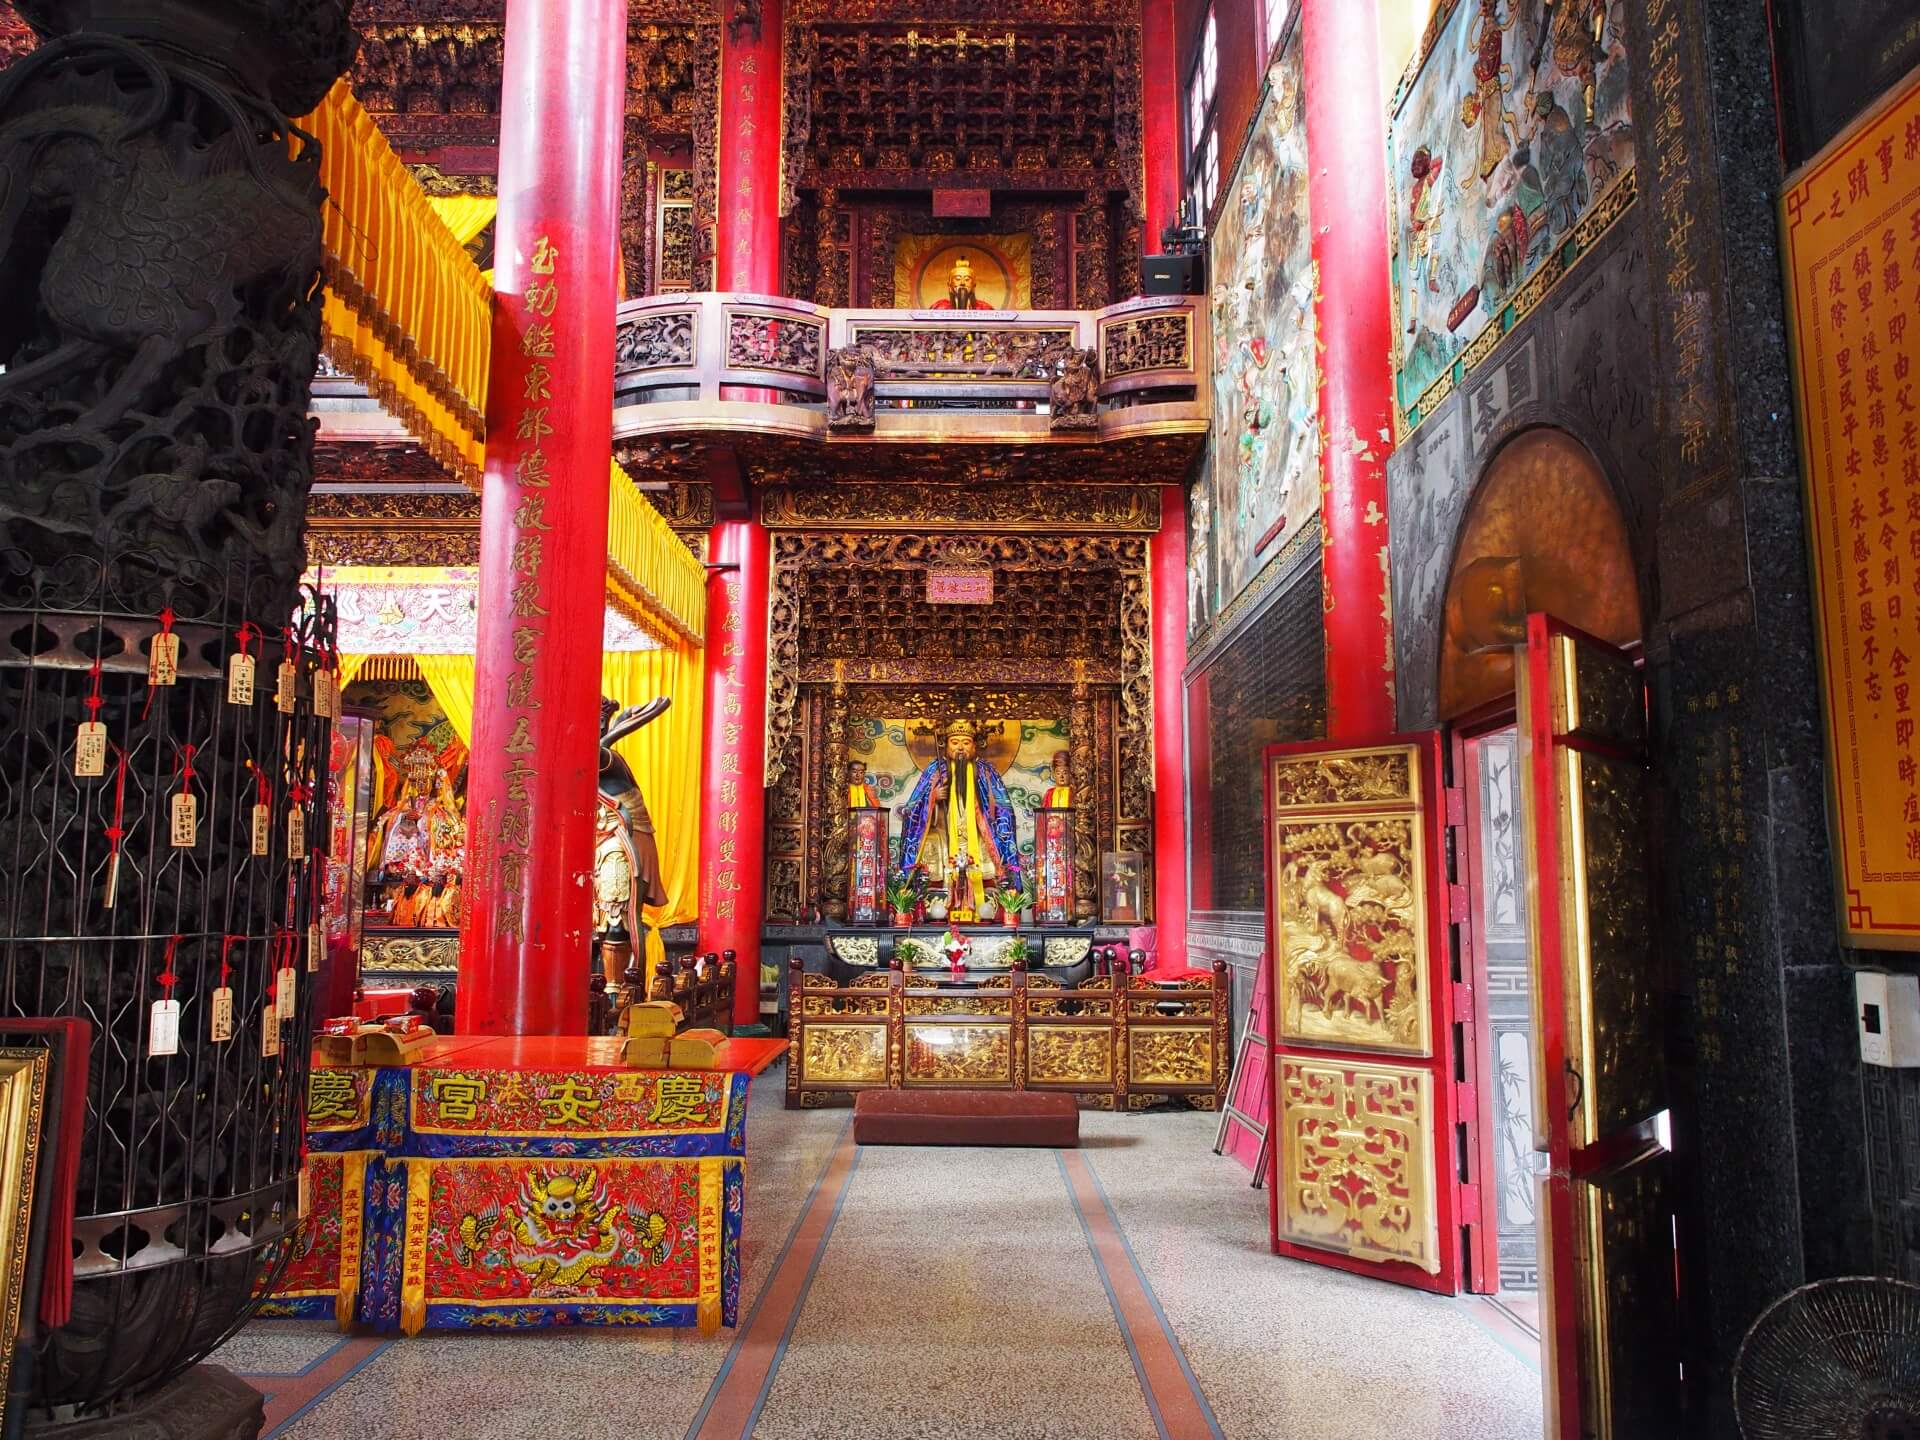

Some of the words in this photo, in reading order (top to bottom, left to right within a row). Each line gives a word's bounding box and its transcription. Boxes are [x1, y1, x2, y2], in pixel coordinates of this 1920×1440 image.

[308, 1071, 358, 1121] 慶
[701, 1205, 718, 1295] 歲次丙申年吉旦
